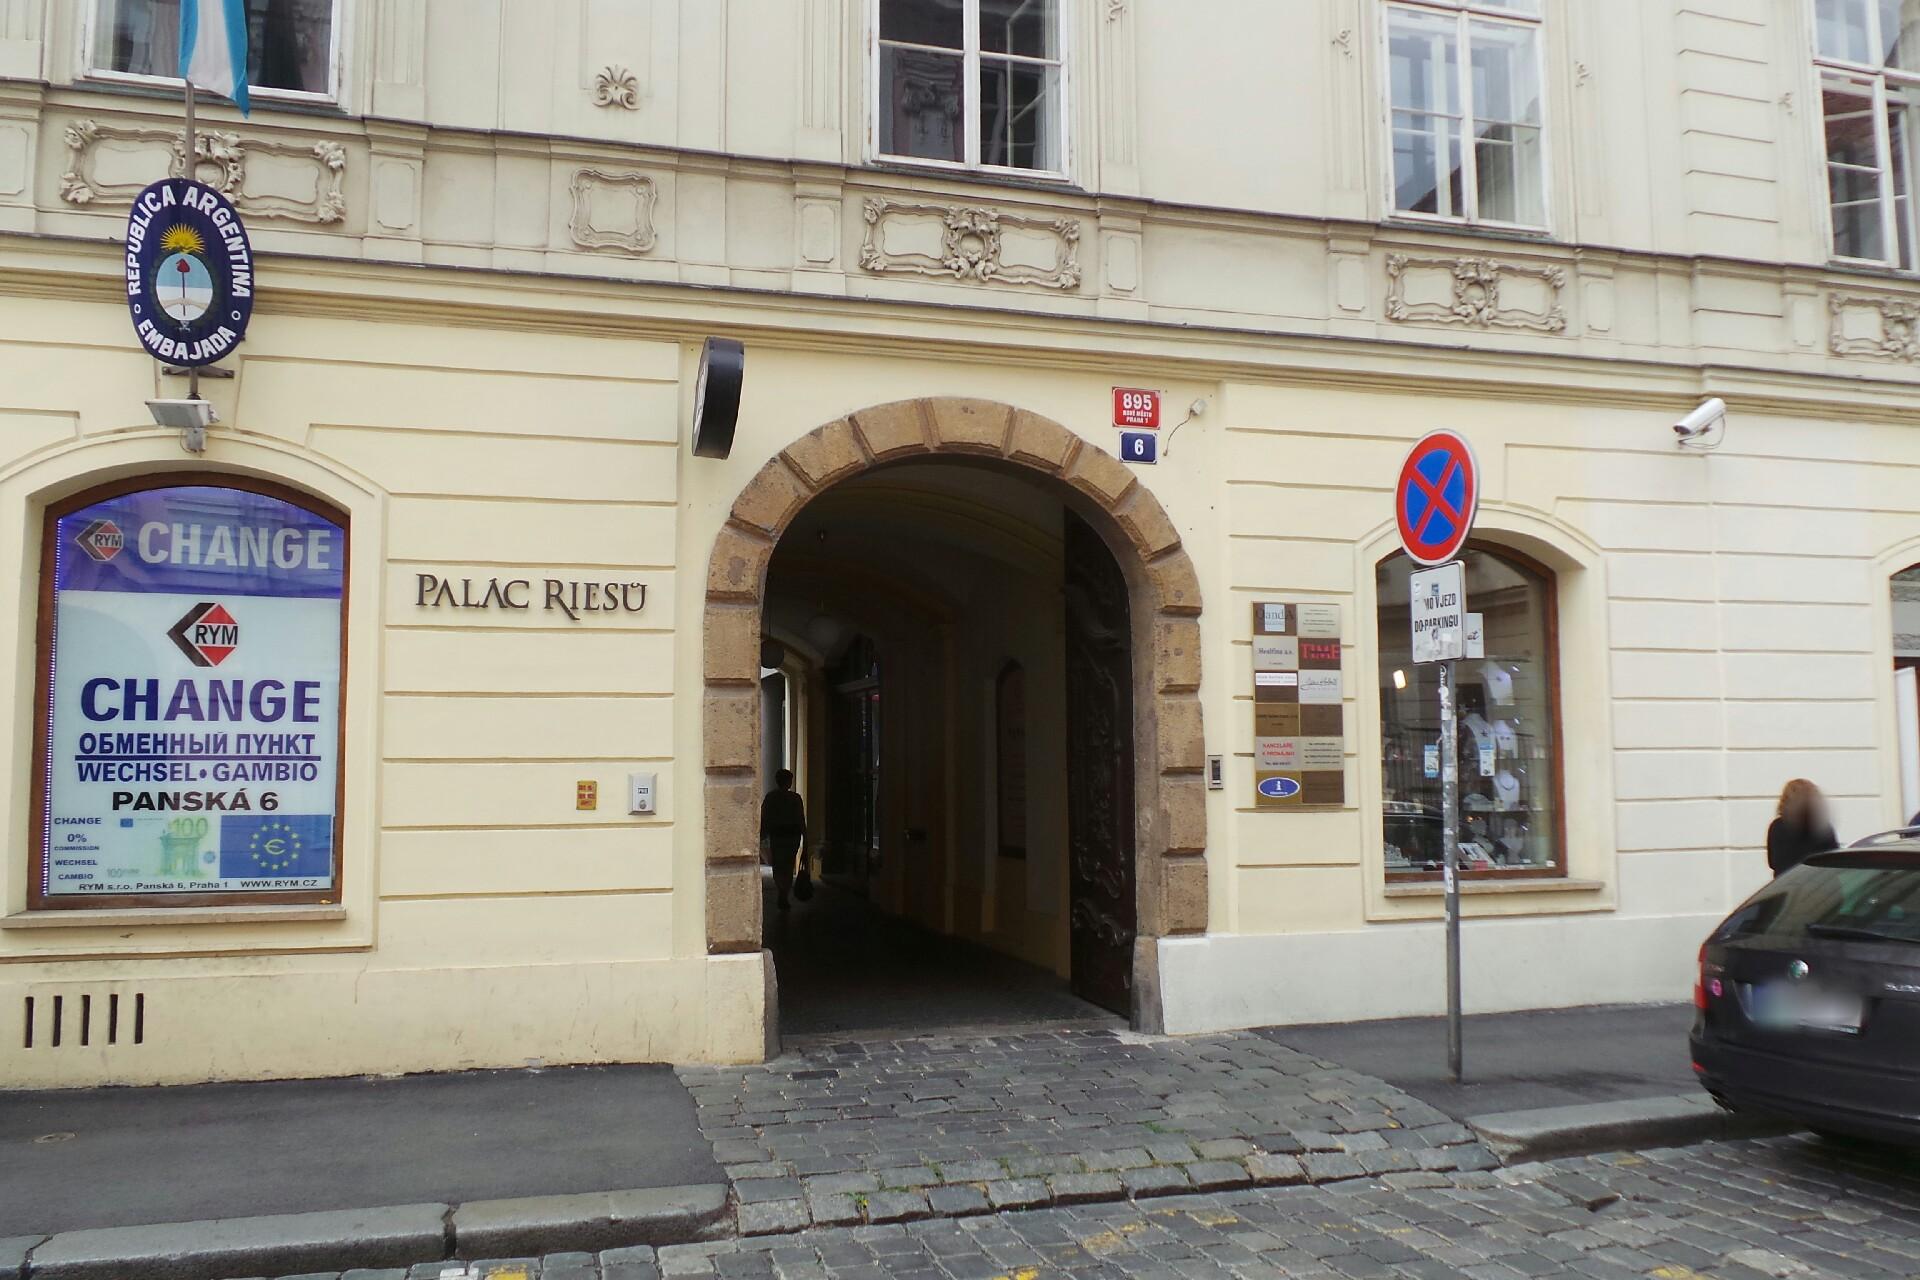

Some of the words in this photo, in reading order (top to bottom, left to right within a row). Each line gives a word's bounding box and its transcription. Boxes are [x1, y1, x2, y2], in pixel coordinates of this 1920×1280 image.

[128, 185, 176, 295] REPUBLICA
[183, 186, 250, 297] ARGENTINA
[138, 318, 236, 360] EMBAJADA
[1123, 393, 1152, 410] 895
[1134, 438, 1143, 455] 6
[95, 533, 122, 546] RYM
[138, 522, 331, 570] CHANGE
[415, 573, 530, 609] PALÁC
[1435, 593, 1456, 608] VJEZD
[195, 624, 238, 645] RYM
[81, 678, 320, 722] CHANGE
[79, 732, 227, 755] ОБМЕННЫЙ
[236, 733, 315, 755] ПУНКТ
[78, 763, 197, 782] WECHSEL
[212, 763, 318, 782] GAMBIO
[112, 788, 251, 811] PANSKÁ
[259, 792, 279, 811] 6
[54, 817, 102, 825] CHANGE
[67, 833, 87, 843] 0%
[190, 881, 220, 889] Praha
[240, 879, 318, 888] WWW.RYM.CZ
